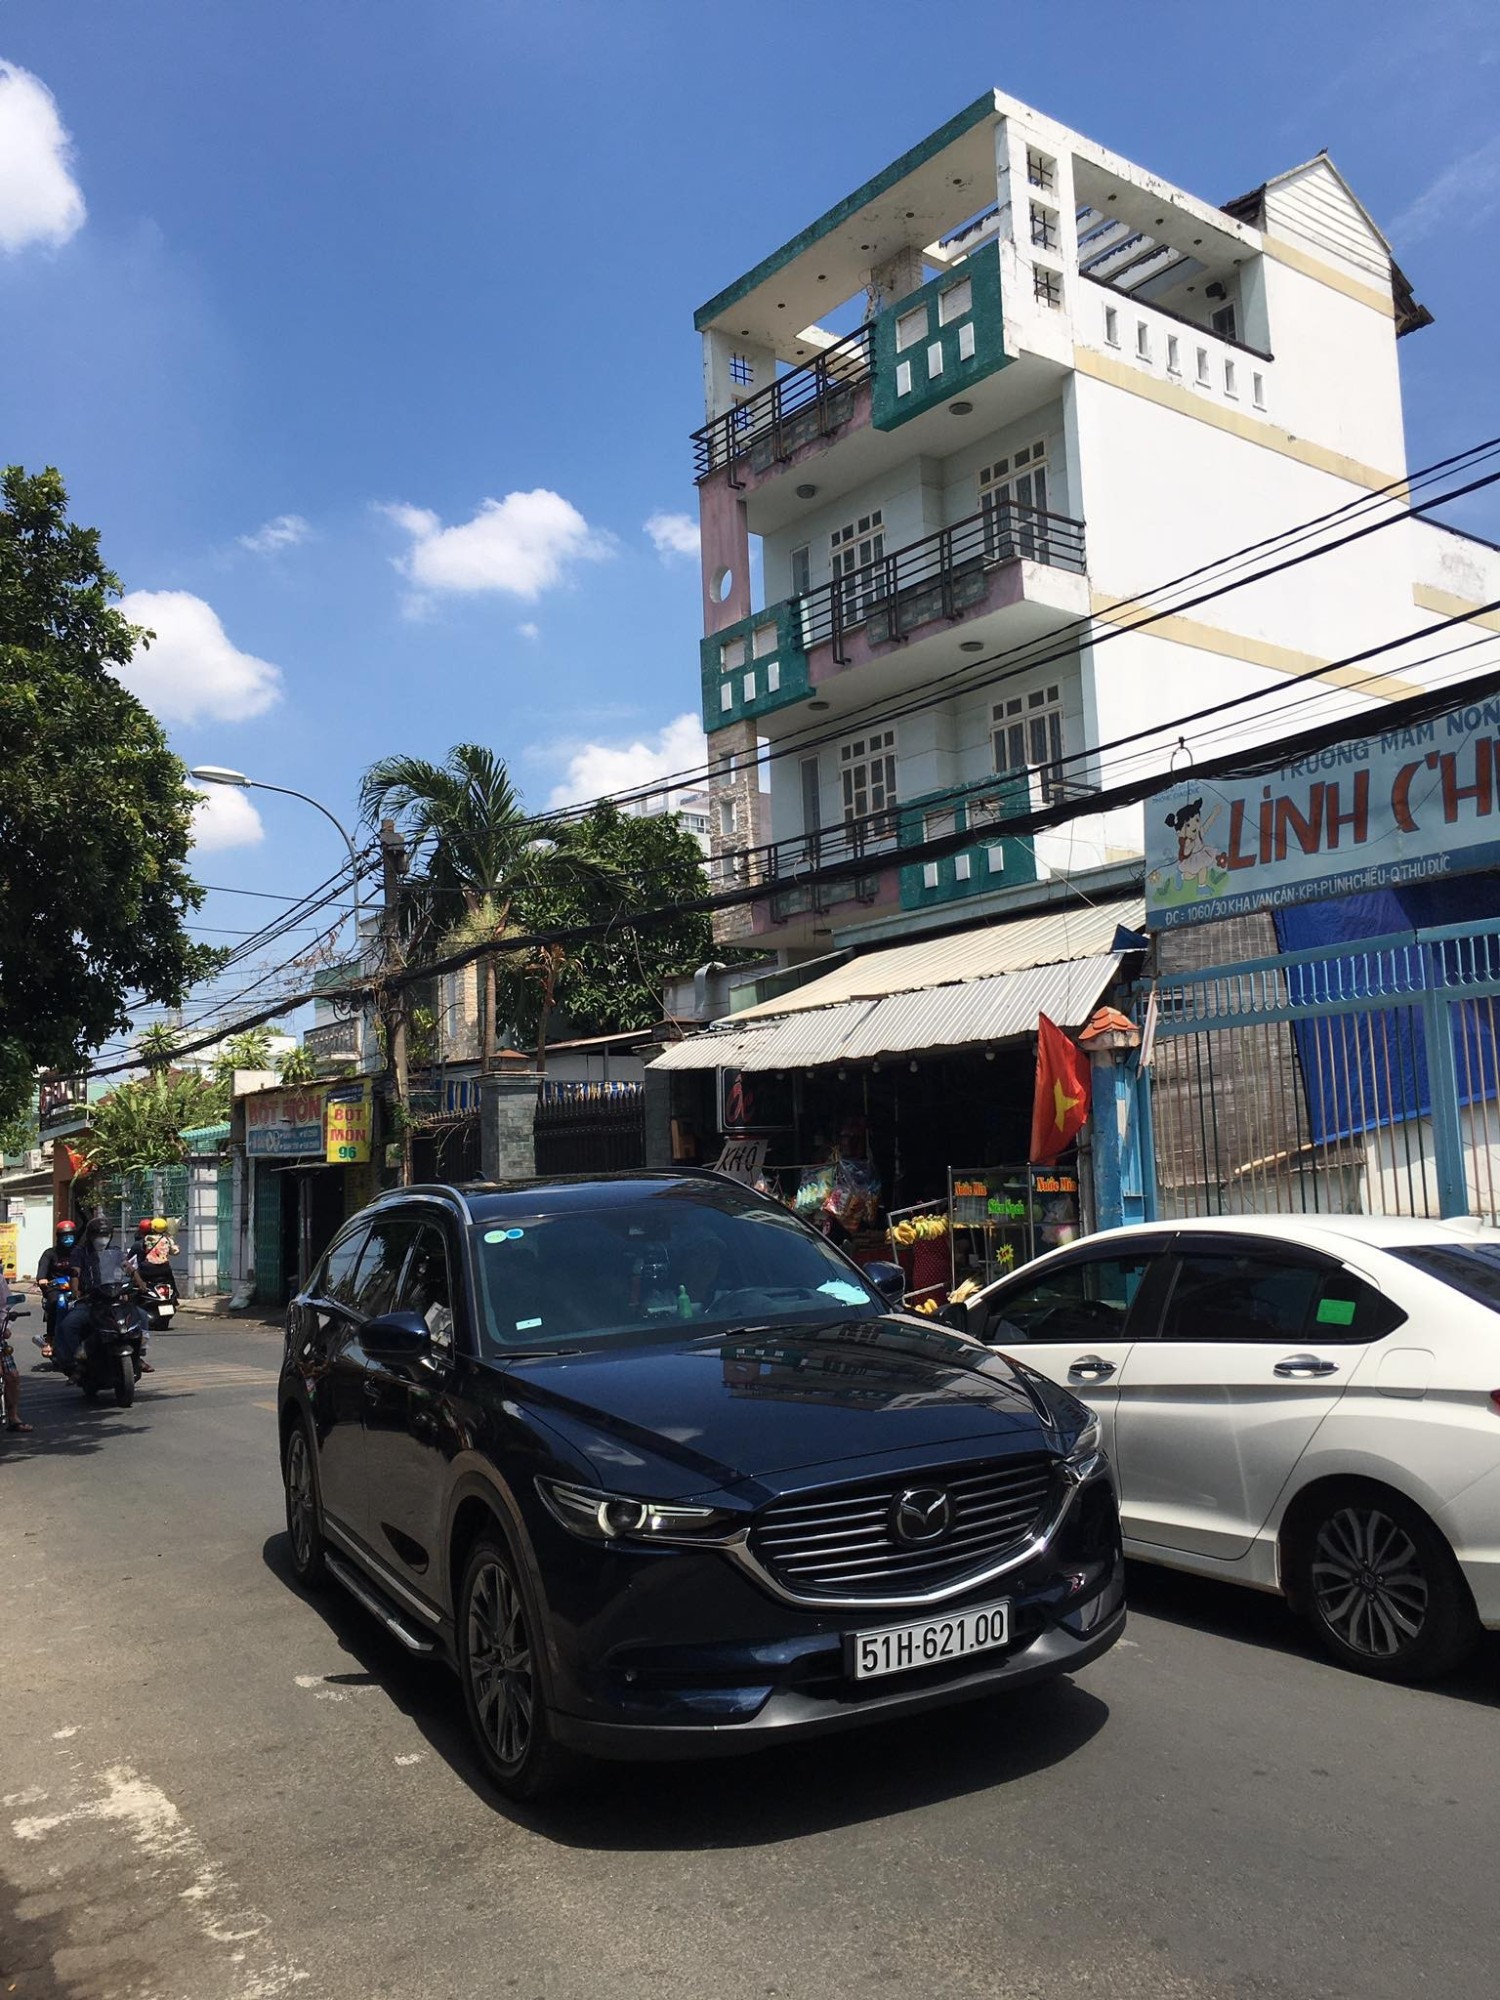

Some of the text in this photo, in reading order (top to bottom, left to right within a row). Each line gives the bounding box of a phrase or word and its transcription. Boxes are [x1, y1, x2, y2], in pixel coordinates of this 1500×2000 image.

[1188, 900, 1226, 921] 1060/30
[1226, 899, 1251, 915] KHA
[1427, 852, 1451, 875] ĐỨC
[339, 1146, 357, 1159] 96
[717, 1141, 760, 1172] KHÔ
[862, 1609, 1004, 1672] 51H-621.00
